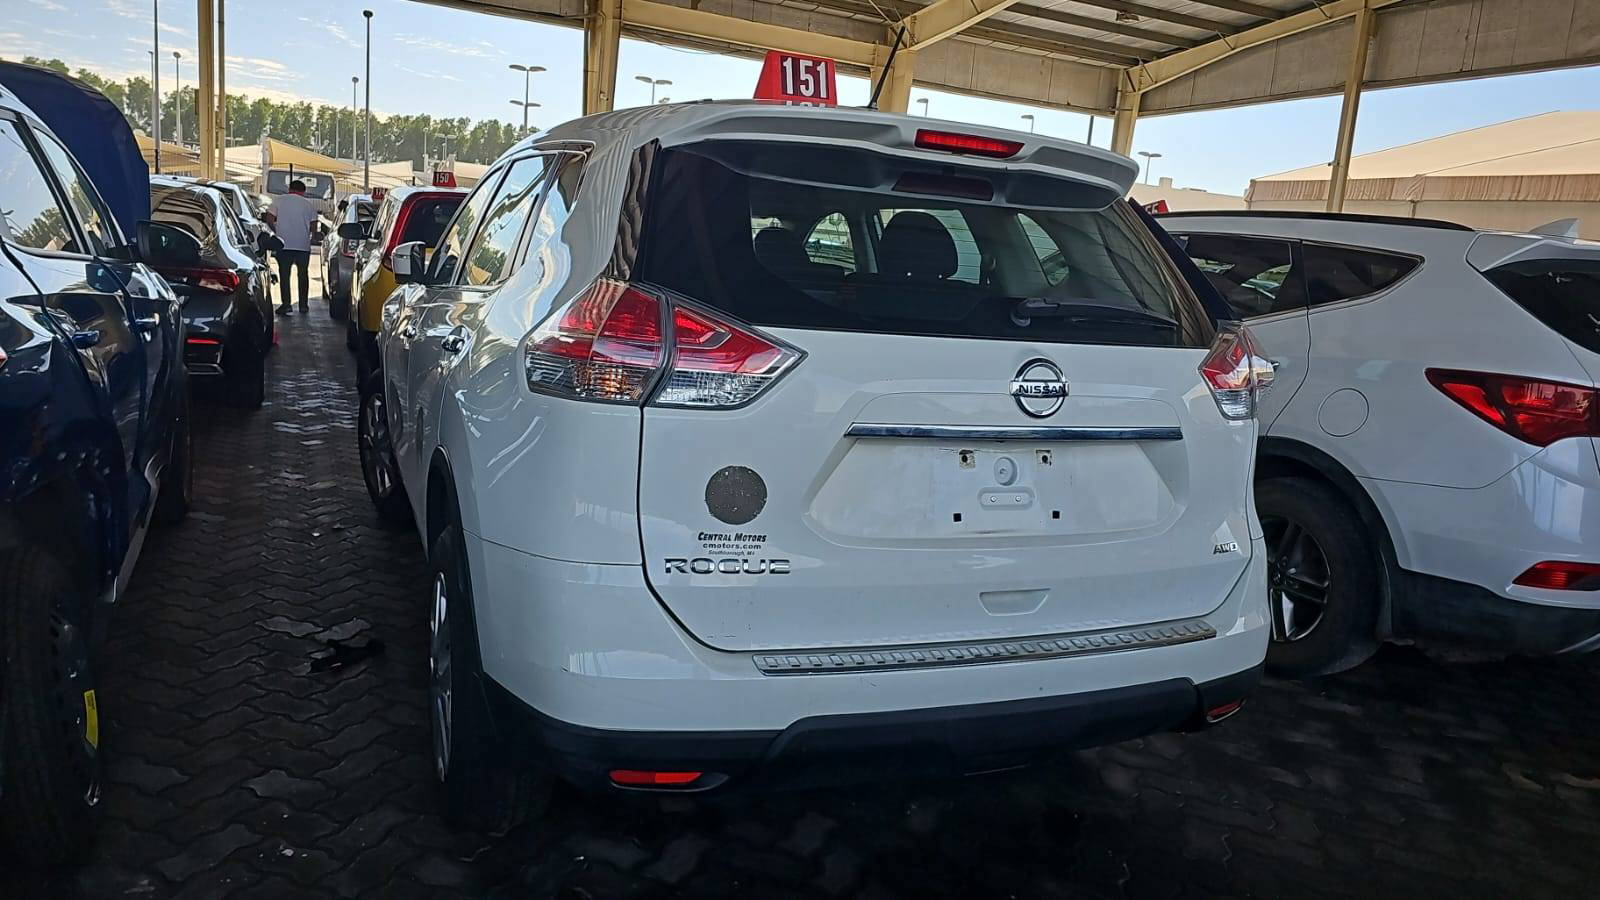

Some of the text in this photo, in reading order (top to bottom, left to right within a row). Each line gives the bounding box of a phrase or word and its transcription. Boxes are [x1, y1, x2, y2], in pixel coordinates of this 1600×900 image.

[783, 57, 827, 98] 151
[435, 172, 449, 184] 150
[1018, 384, 1066, 395] NISSAN
[1213, 542, 1238, 554] AWD
[664, 557, 791, 575] ROGUE
